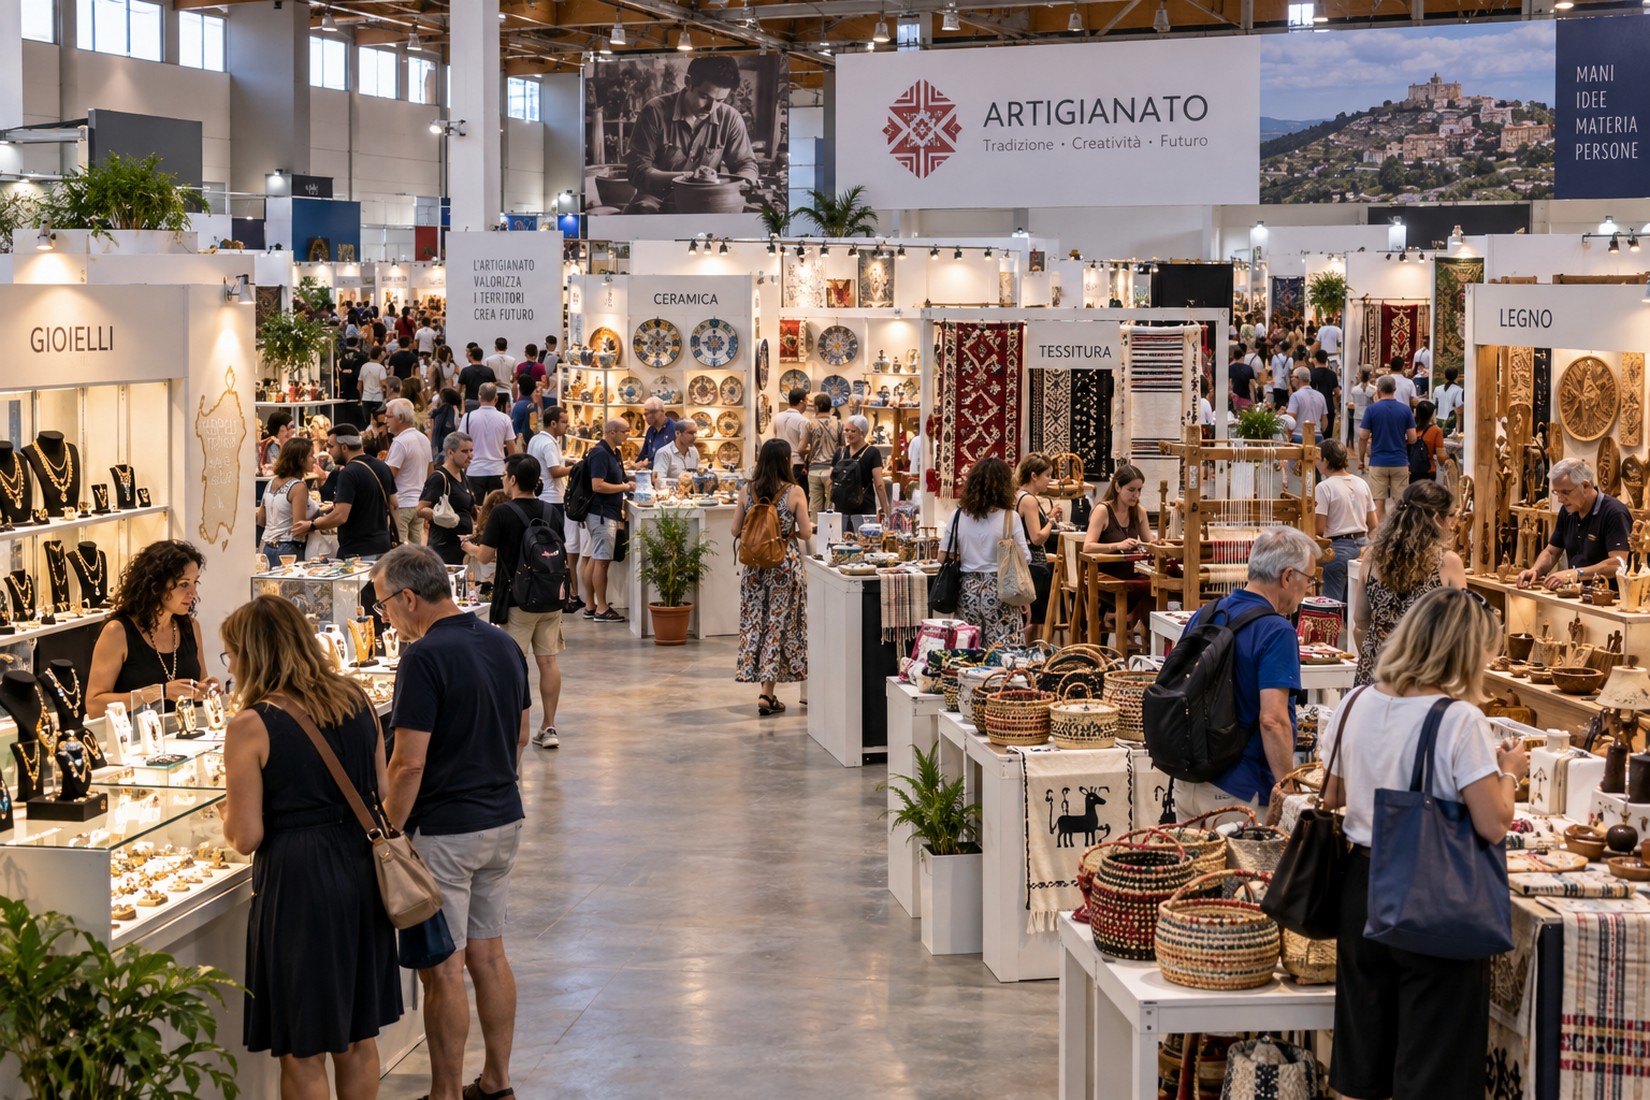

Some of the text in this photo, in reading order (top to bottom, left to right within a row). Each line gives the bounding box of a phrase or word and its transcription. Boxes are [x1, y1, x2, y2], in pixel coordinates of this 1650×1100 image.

[1576, 63, 1614, 83] MANI
[1576, 90, 1607, 109] IDEE
[982, 94, 1209, 128] ARTIGIANATO
[1575, 115, 1638, 135] MATERIA
[982, 134, 1208, 152] Tradizione Creatività Futuro
[1575, 141, 1639, 161] PERSONE
[473, 259, 535, 272] L'ARTIGIANATO
[473, 275, 522, 288] VALORIZZA
[473, 291, 525, 304] I TERRITORI
[653, 292, 719, 305] CERAMICA
[473, 307, 535, 321] CREA FUTURO
[1499, 308, 1553, 329] LEGNO
[30, 325, 113, 353] GIOIELLI
[1038, 344, 1112, 359] TESSITURA
